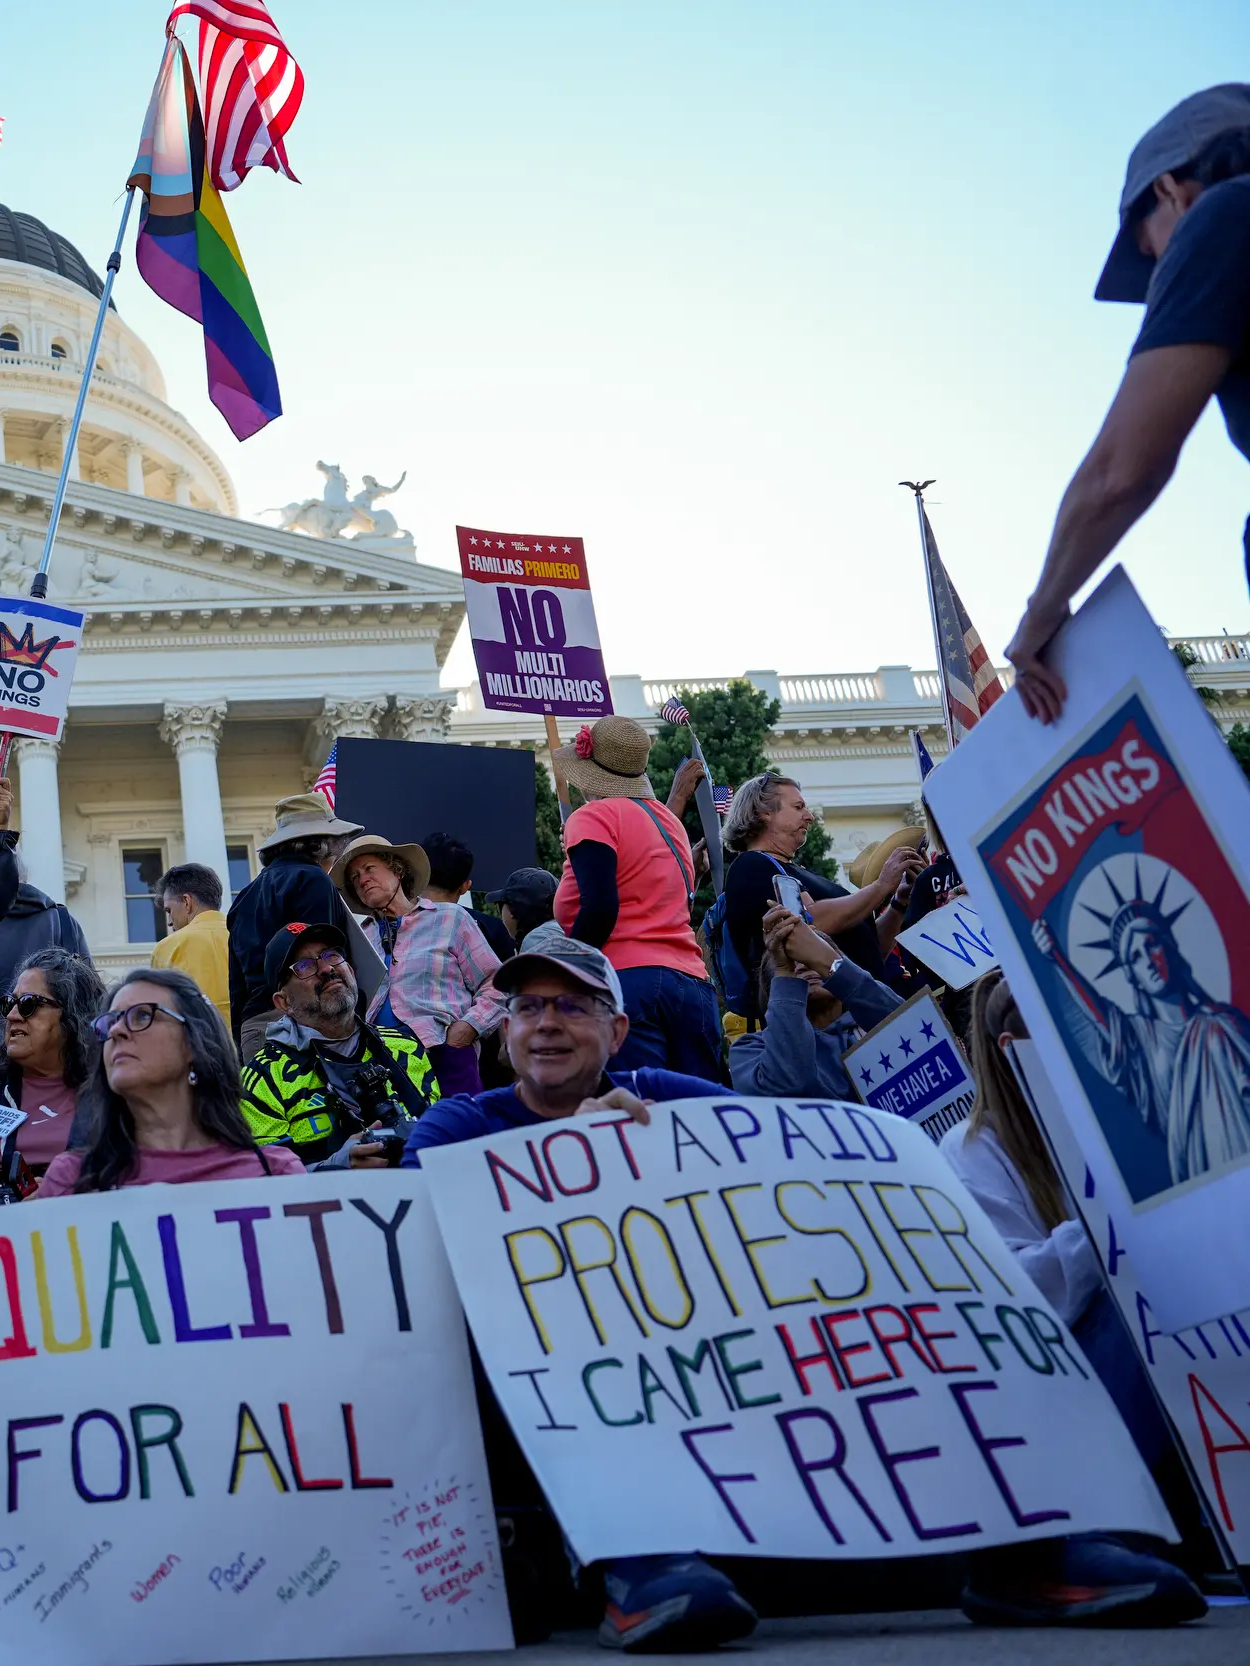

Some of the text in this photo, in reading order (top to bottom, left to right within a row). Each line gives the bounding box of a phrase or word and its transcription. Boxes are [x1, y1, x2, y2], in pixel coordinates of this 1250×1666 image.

[468, 553, 580, 580] FAMILIAS PRIMERO
[497, 586, 568, 648] NO
[485, 672, 605, 703] MILLIONARIOS
[514, 650, 566, 676] MULTI
[1005, 739, 1161, 900] NO KINGS
[877, 1056, 952, 1114] WE HAVE A
[484, 1104, 897, 1212] NOT A PAID
[504, 1179, 1013, 1356] PROTESTER
[508, 1368, 578, 1431] I
[582, 1328, 782, 1428] CAME
[775, 1303, 977, 1397] HERE
[961, 1300, 1090, 1381] FOR
[7, 1402, 393, 1513] FOR ALL
[680, 1380, 1071, 1547] FREE
[393, 1485, 461, 1528] IT IS NOT
[207, 1551, 245, 1592] Poor
[402, 1527, 465, 1561] THERE IS
[415, 1542, 467, 1575] ENOUGH
[3, 1561, 47, 1605] HUMANS
[34, 1539, 114, 1623] Immigrants
[130, 1553, 182, 1603] Women
[276, 1545, 331, 1604] Religious
